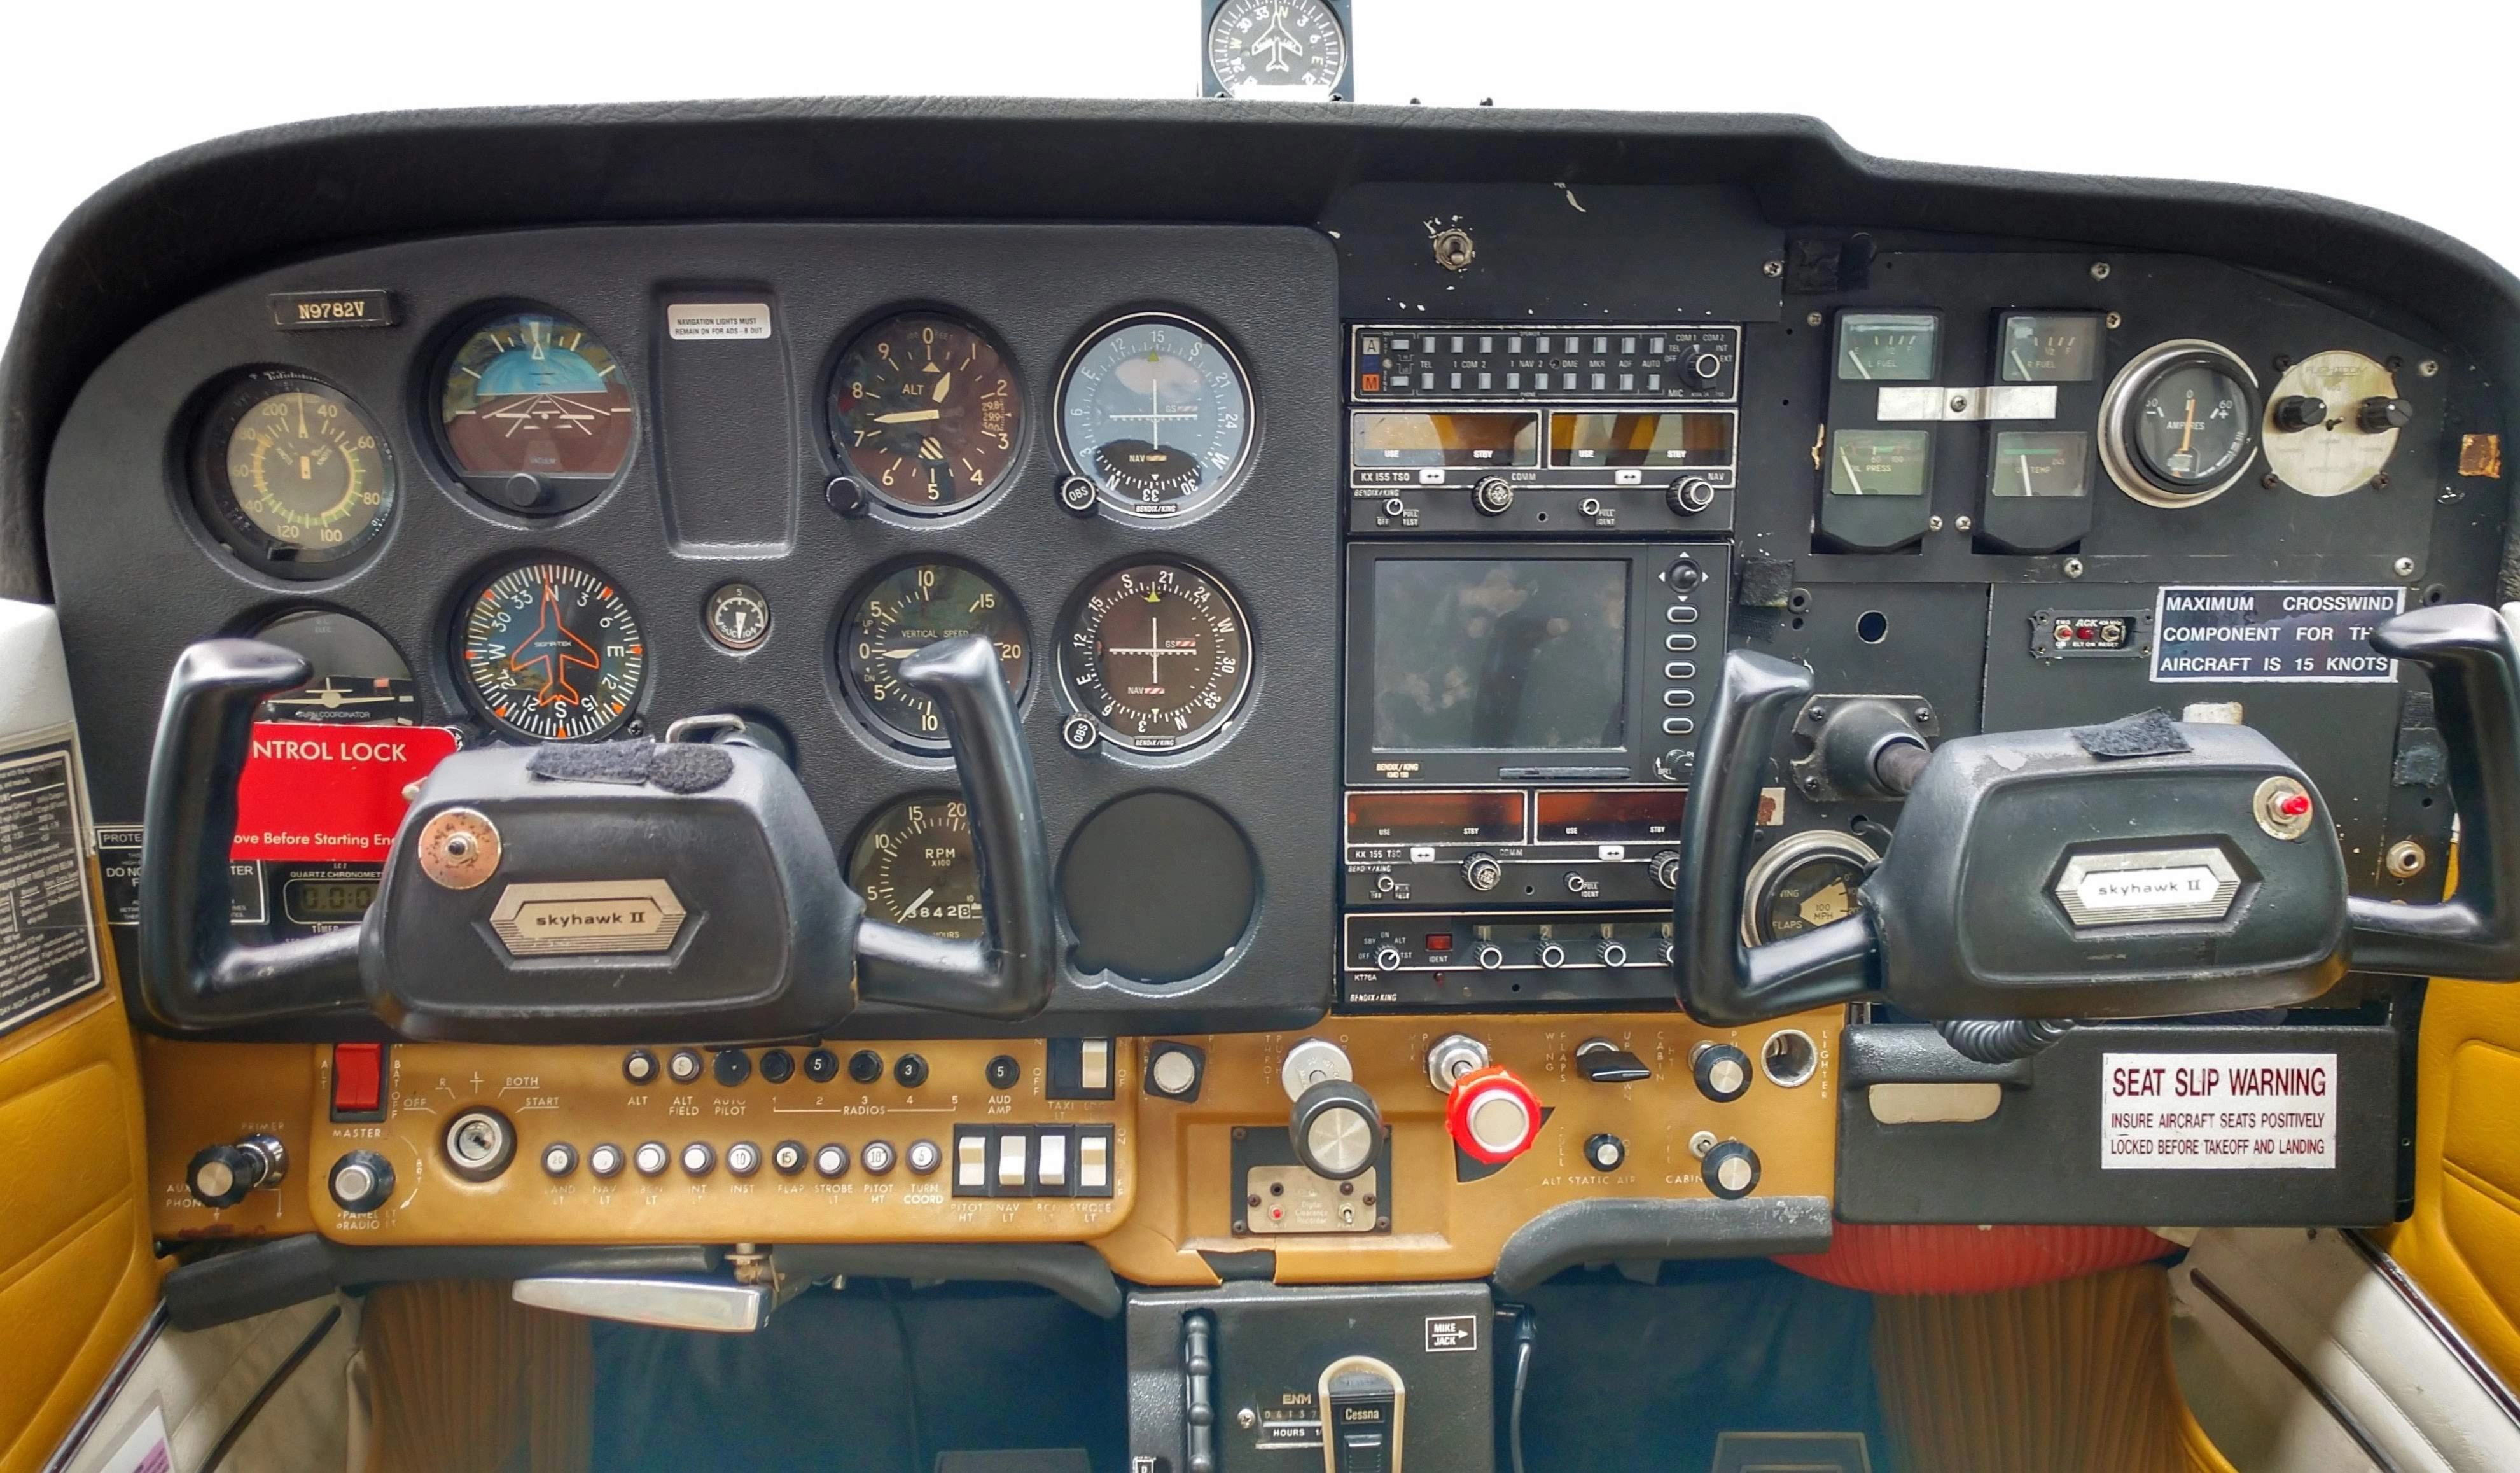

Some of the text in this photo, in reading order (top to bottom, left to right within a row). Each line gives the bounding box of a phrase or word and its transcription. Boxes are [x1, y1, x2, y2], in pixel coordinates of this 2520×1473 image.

[1254, 6, 1270, 20] 33
[298, 300, 365, 319] N9782V
[878, 342, 889, 360] 9
[1367, 339, 1377, 352] A
[997, 380, 1008, 396] 2
[1364, 377, 1377, 389] M
[852, 382, 863, 398] 8
[902, 384, 924, 395] ALT
[1668, 389, 1683, 398] MIC
[854, 431, 865, 447] 7
[998, 433, 1009, 449] 3
[1129, 454, 1145, 463] NAV
[882, 469, 894, 485] 6
[970, 469, 984, 485] 4
[1361, 473, 1410, 481] KX 155 TSO
[928, 484, 940, 500] 5
[1068, 485, 1089, 501] OBS
[277, 526, 300, 538] 120
[321, 529, 342, 542] 100
[918, 571, 935, 587] 10
[980, 594, 995, 608] 15
[2166, 597, 2394, 611] MAXIMUM CROSSWIND
[2163, 627, 2373, 641] COMPONENT FOR TH
[2161, 657, 2388, 671] AIRCRAFT IS 15 KNOTS
[922, 715, 938, 731] 10
[1073, 723, 1089, 743] OBS
[253, 740, 407, 762] NTROL LOCK
[908, 806, 923, 821] 15
[947, 802, 967, 818] 20
[263, 832, 310, 845] Before
[315, 834, 369, 848] Starting
[875, 834, 890, 849] 10
[925, 848, 956, 859] RPM
[1387, 849, 1401, 858] TSO
[106, 868, 125, 877] DO
[2099, 880, 2200, 896] skyhawk II
[536, 912, 645, 927] skyhawk II
[1820, 1030, 1828, 1100] LIGHTER
[506, 1077, 539, 1086] BOTH
[2113, 1068, 2326, 1097] SEAT SLIP WARNING
[403, 1098, 426, 1107] OFF
[526, 1098, 559, 1106] START
[627, 1096, 648, 1105] ALT
[673, 1096, 693, 1105] ALT
[988, 1096, 1011, 1104] AUD
[1048, 1101, 1074, 1110] TAXI
[669, 1107, 699, 1115] FIELD
[715, 1107, 746, 1115] PILOT
[843, 1106, 885, 1115] RADIOS
[988, 1106, 1012, 1114] AMP
[2112, 1113, 2325, 1128] INSURE AIRCRAFT SEATS POSITIVELY
[241, 1122, 284, 1131] PRIMER
[332, 1129, 382, 1138] MASTER
[2111, 1139, 2324, 1154] LOCKED BEFORE TAKEOFF AND LANDING
[1542, 1176, 1636, 1186] ALT STATIC AIR
[1666, 1175, 1703, 1184] CABIN
[593, 1185, 616, 1194] NAV
[688, 1185, 707, 1193] INT
[777, 1185, 805, 1193] FLAP
[814, 1184, 853, 1193] STROBE
[863, 1184, 893, 1193] PITOT
[910, 1184, 938, 1193] TURN
[871, 1196, 885, 1204] HT
[903, 1196, 943, 1204] COORD
[951, 1204, 983, 1212] PITOT
[996, 1204, 1019, 1212] NAV
[343, 1221, 380, 1230] RADIO
[1434, 1323, 1456, 1332] MIKE
[1434, 1337, 1456, 1346] JACK
[1283, 1393, 1311, 1405] ENM
[1346, 1409, 1379, 1420] Cessna
[1273, 1428, 1304, 1437] HOURS
